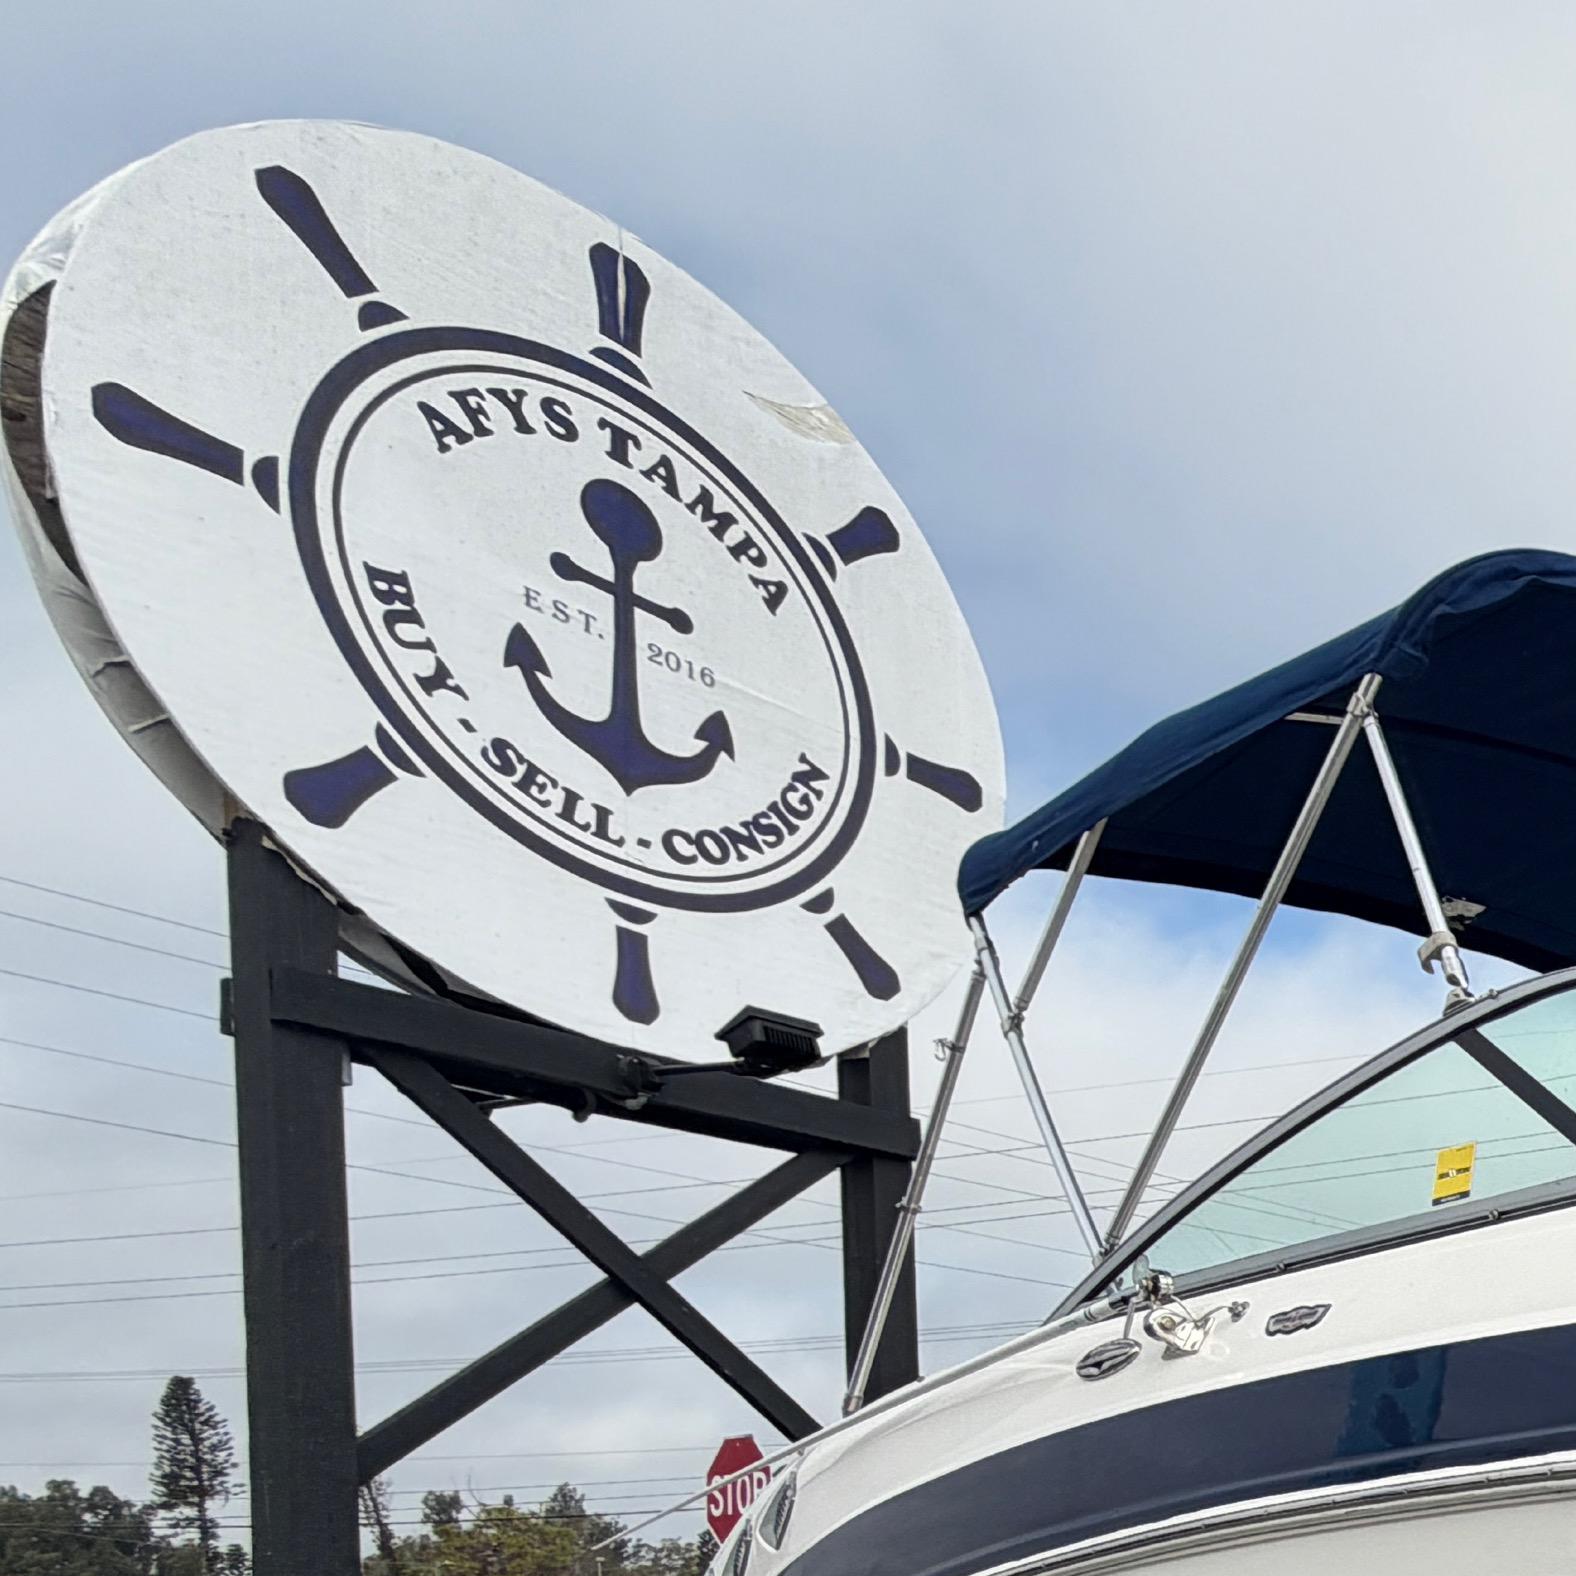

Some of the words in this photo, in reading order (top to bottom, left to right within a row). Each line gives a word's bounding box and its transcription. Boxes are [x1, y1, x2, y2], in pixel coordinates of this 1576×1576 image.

[417, 387, 580, 453] AFYS
[598, 417, 790, 616] TAMPA
[363, 561, 469, 701] BUY
[481, 737, 625, 850] SELL
[661, 753, 830, 865] CONSIGN
[522, 585, 606, 639] EST.
[646, 643, 716, 689] 2016
